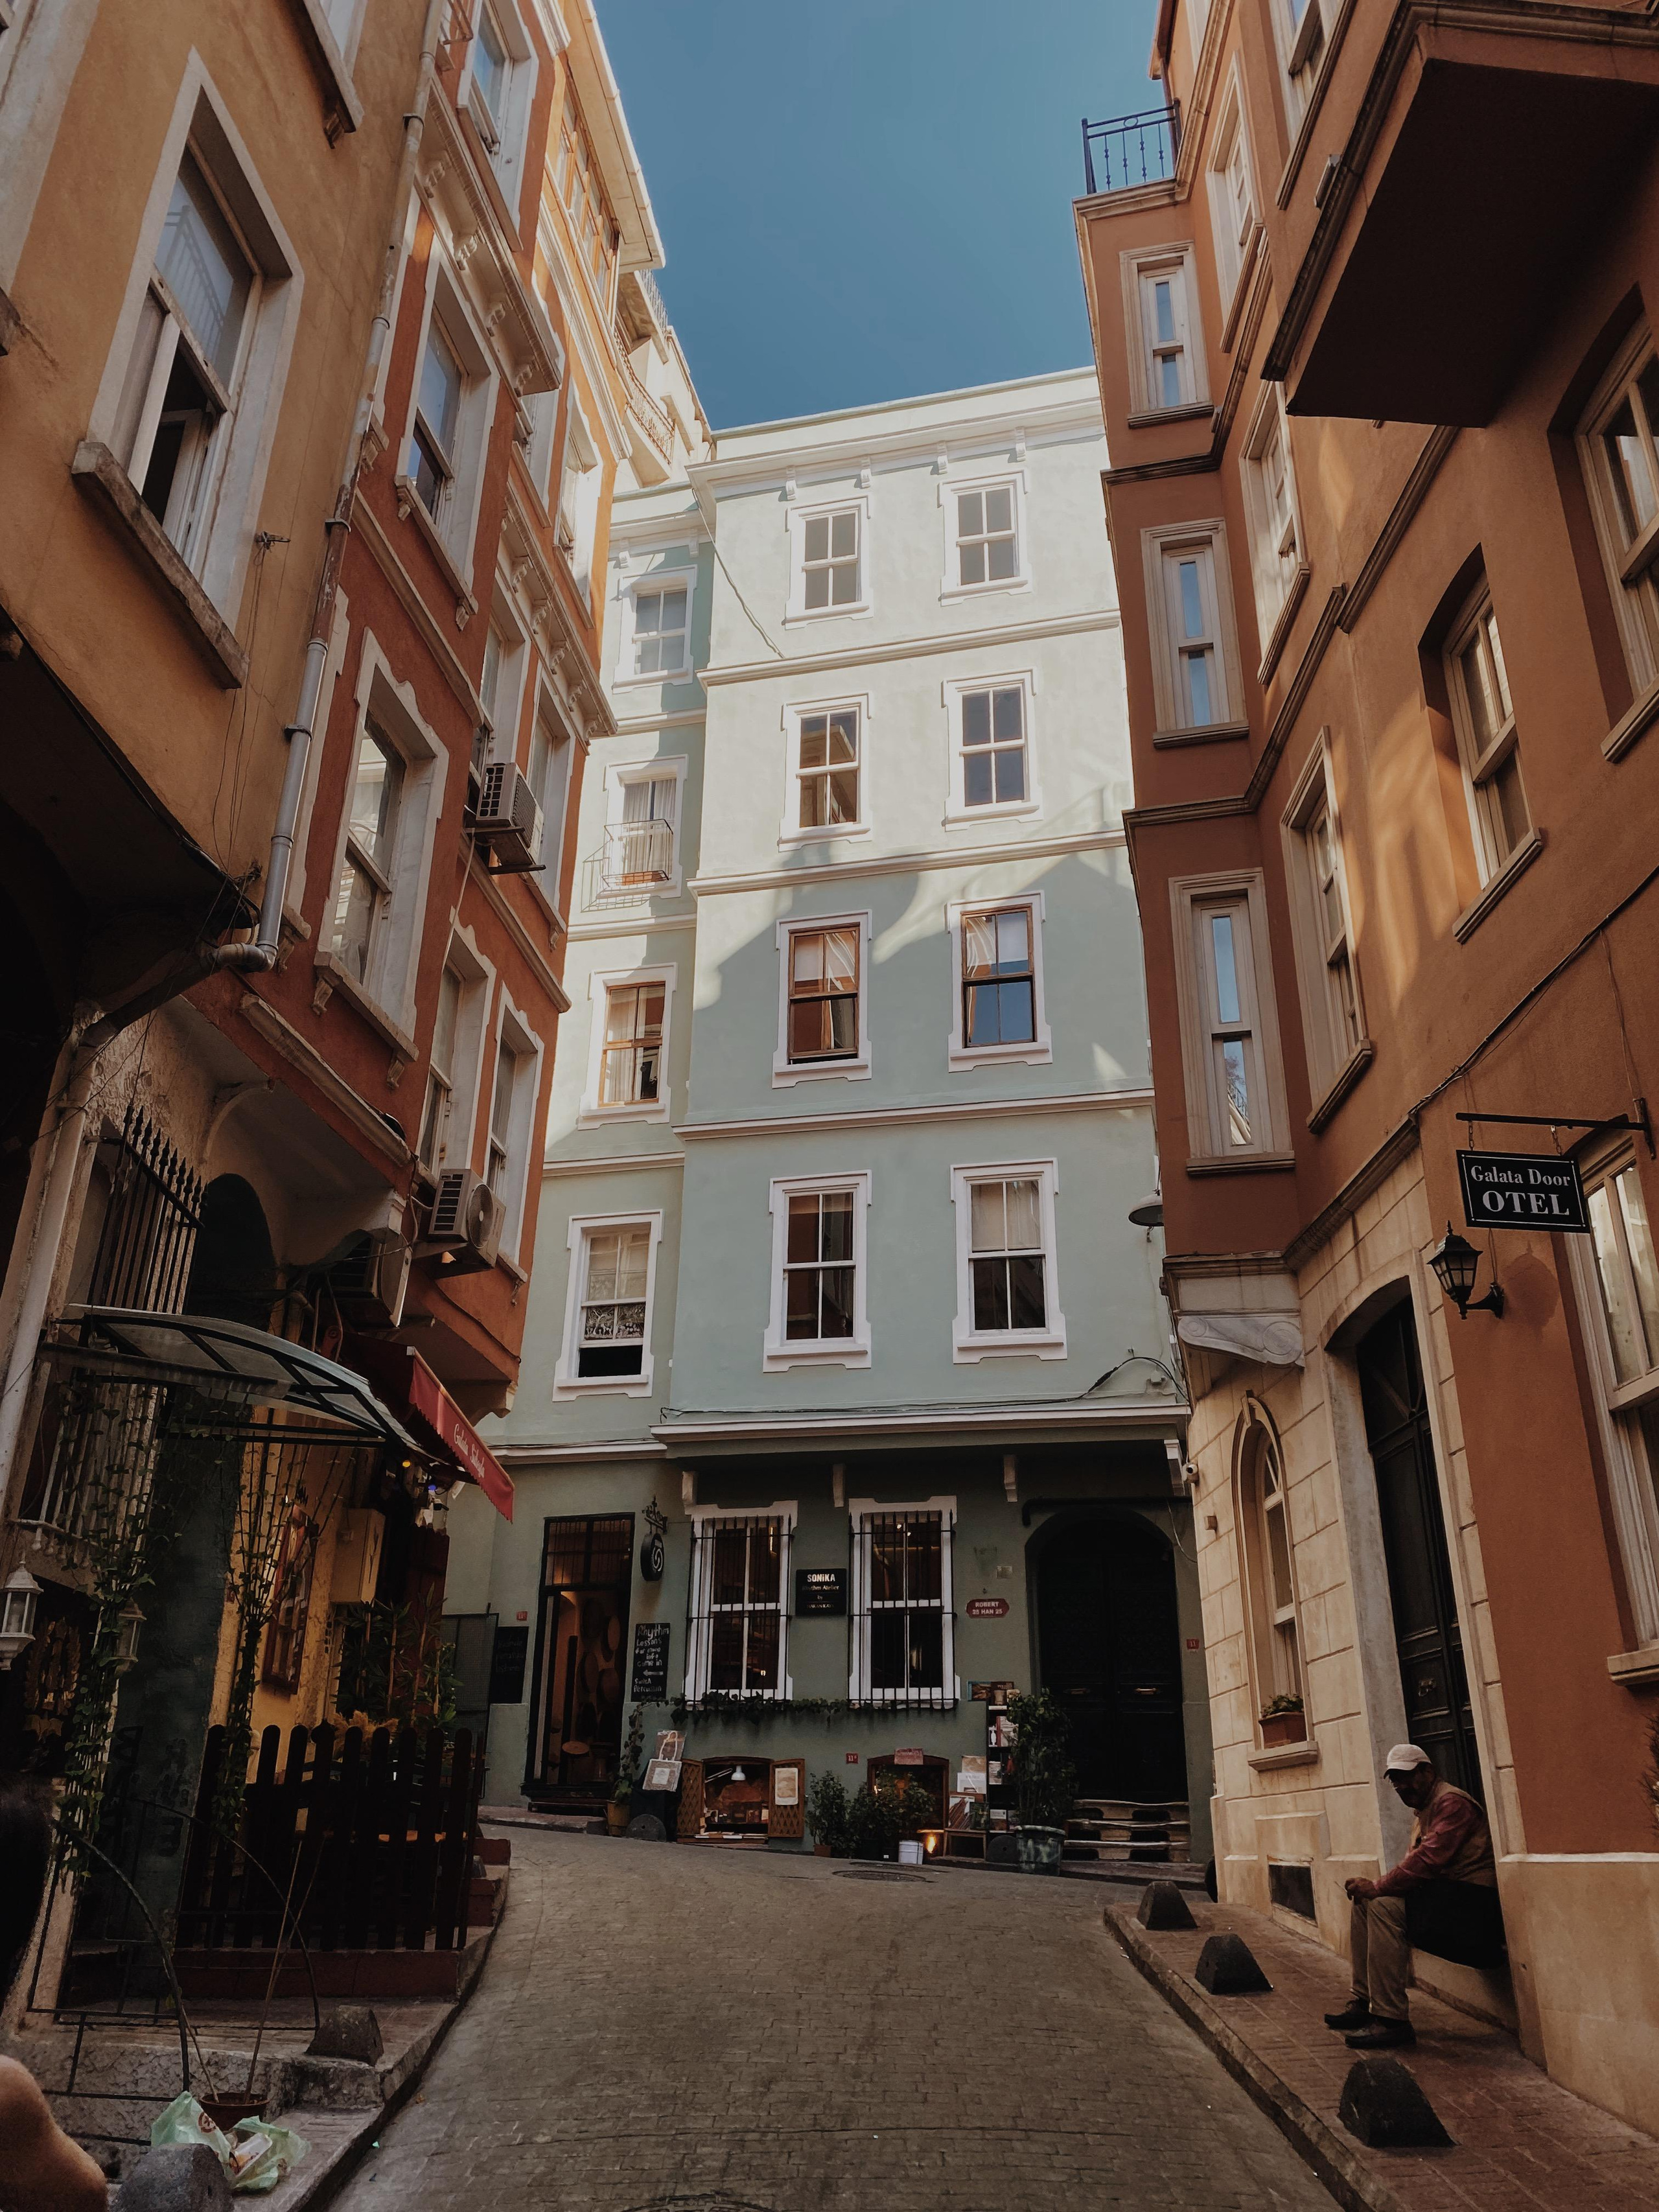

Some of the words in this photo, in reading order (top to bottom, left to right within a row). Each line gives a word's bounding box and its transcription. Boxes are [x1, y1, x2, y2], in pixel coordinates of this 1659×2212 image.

[1470, 1165, 1524, 1184] Galata
[1527, 1169, 1571, 1187] Door
[1482, 1191, 1570, 1216] OTEL
[637, 1624, 669, 1641] Rhythm
